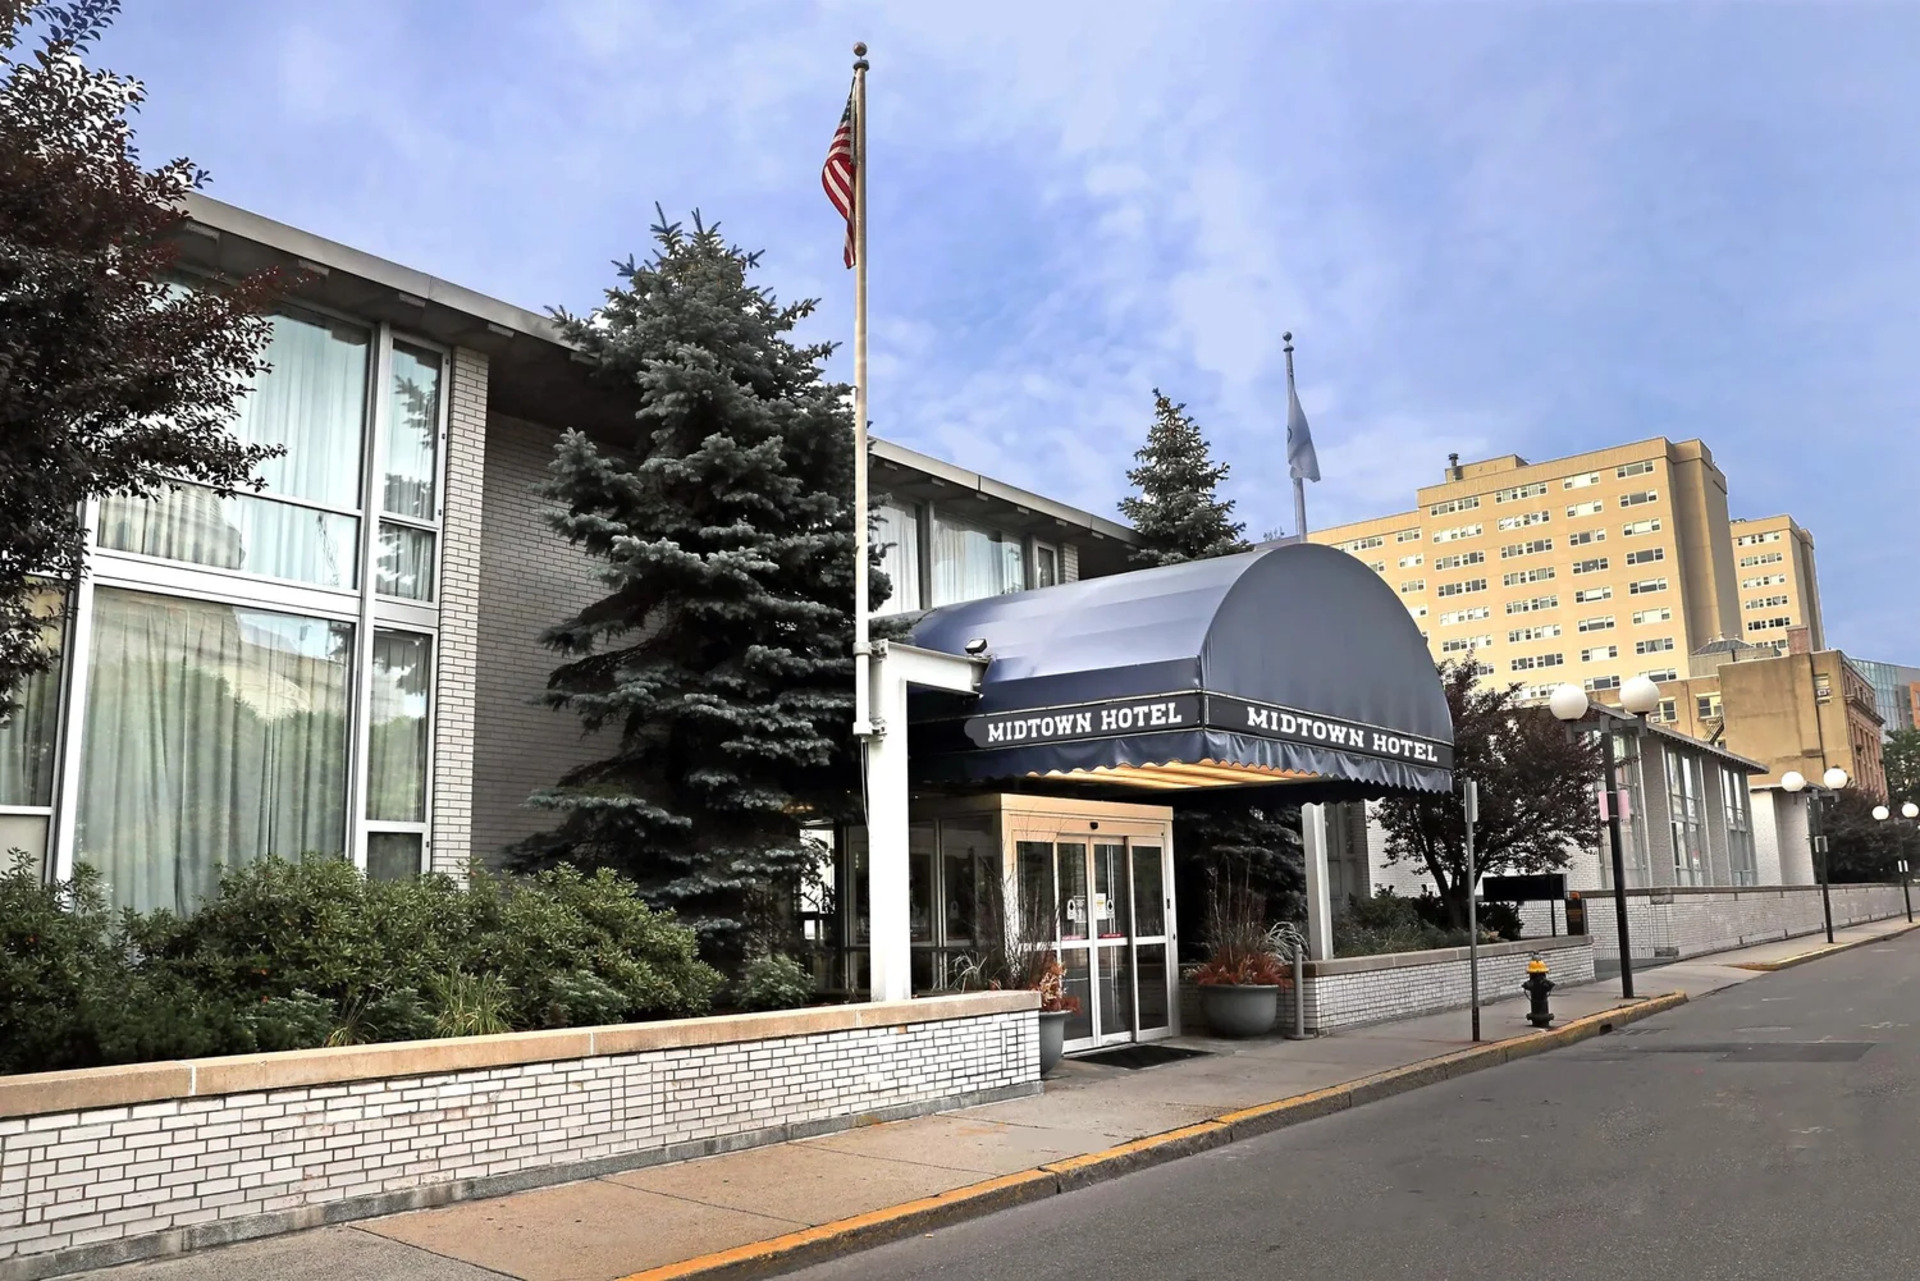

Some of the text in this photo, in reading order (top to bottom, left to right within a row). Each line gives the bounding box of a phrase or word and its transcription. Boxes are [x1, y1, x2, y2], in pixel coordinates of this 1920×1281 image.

[987, 702, 1182, 742] MIDTOWN HOTEL
[1247, 706, 1438, 763] MIDTOWN HOTEL
